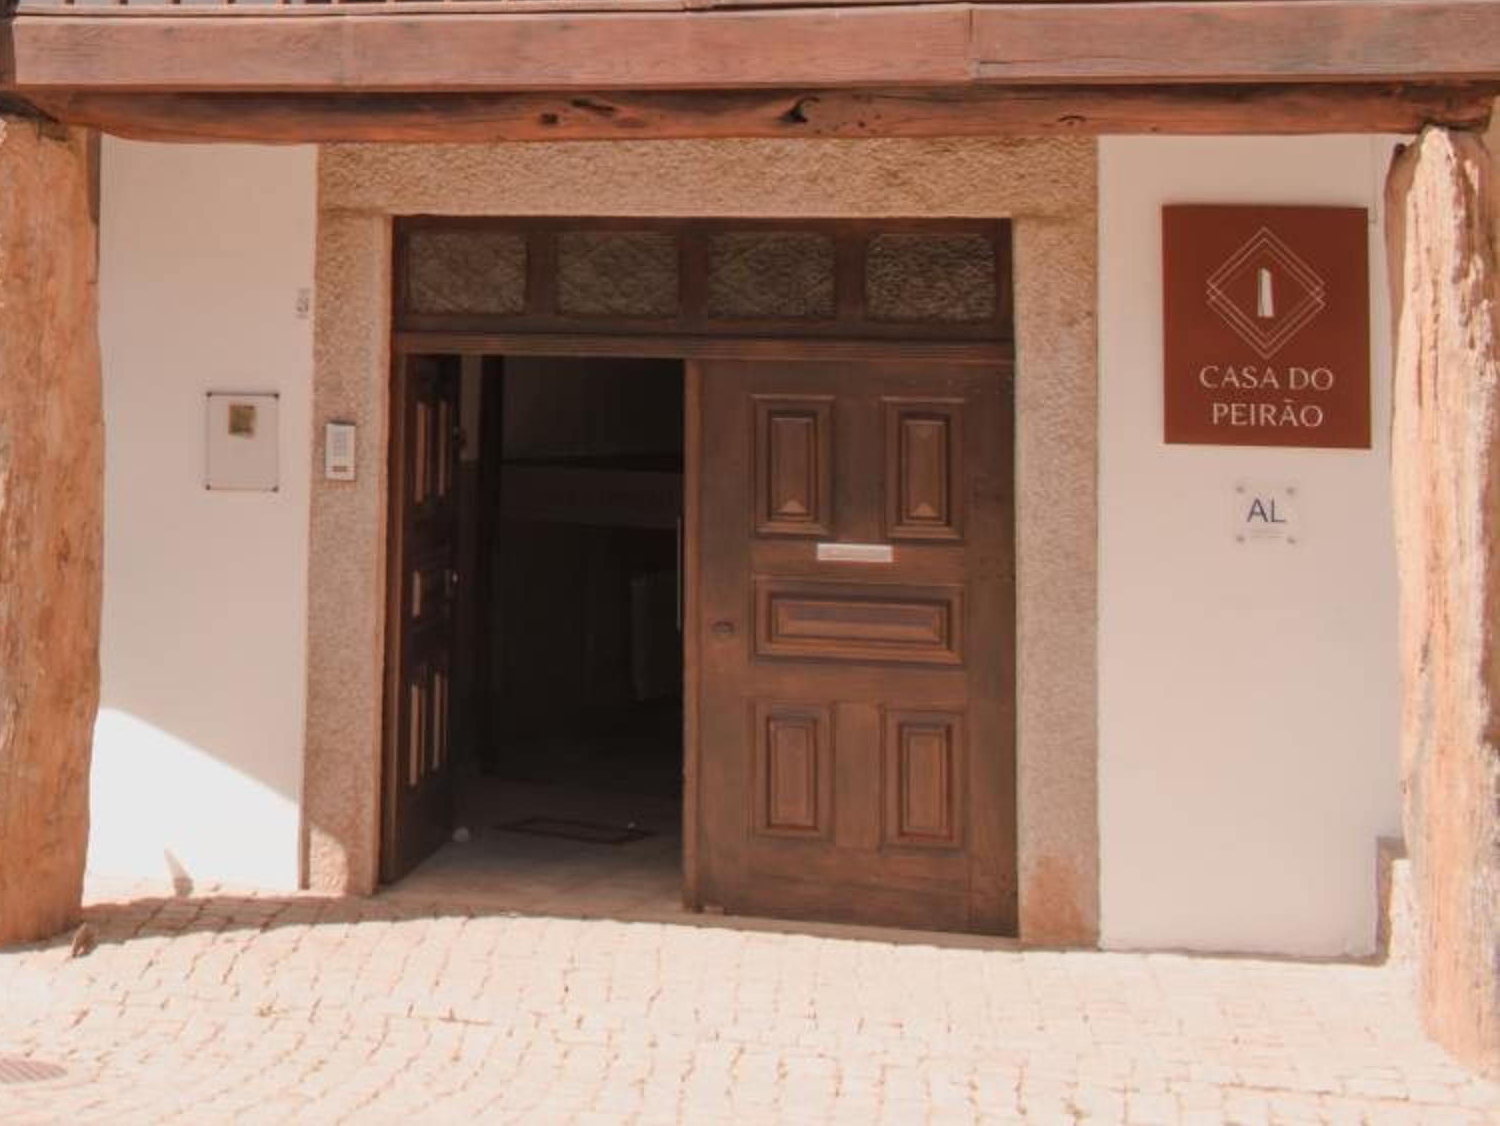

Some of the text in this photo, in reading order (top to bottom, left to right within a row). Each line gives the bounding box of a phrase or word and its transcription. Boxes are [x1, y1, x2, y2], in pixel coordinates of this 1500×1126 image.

[1199, 365, 1334, 391] CASA DO
[1212, 399, 1324, 428] PEIRÃO
[1246, 497, 1287, 523] AL
